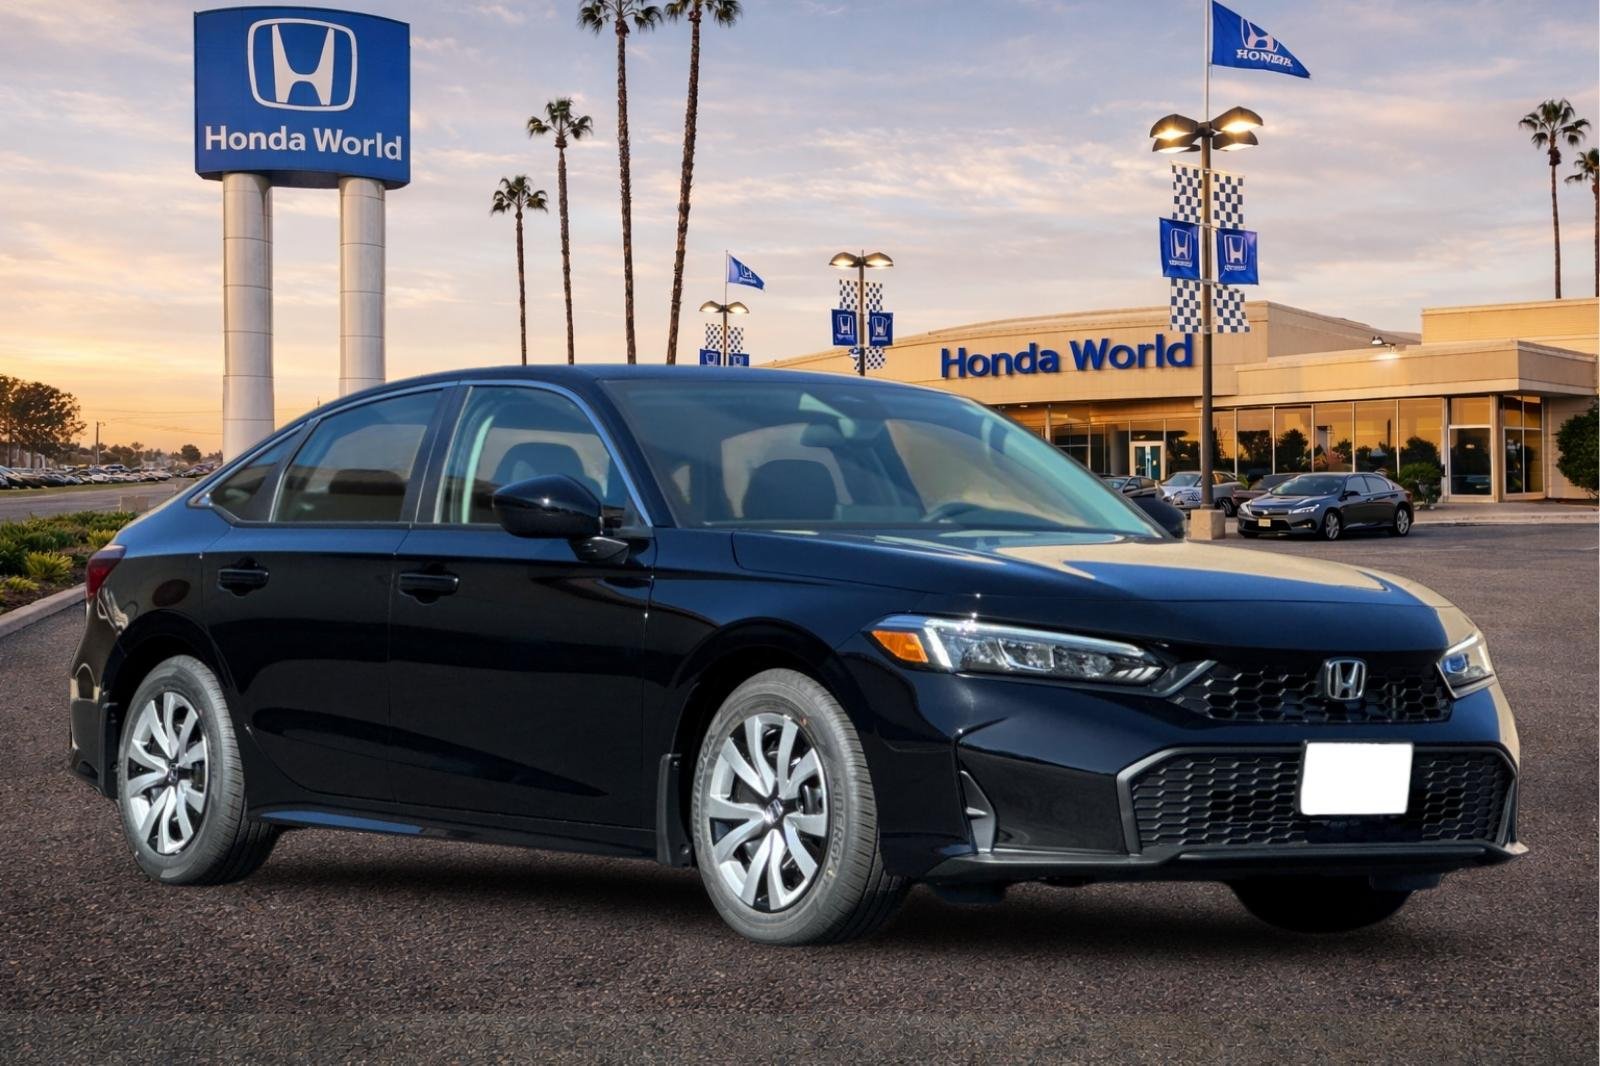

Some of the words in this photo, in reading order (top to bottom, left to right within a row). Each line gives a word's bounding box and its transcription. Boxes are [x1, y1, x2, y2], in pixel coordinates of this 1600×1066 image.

[205, 125, 306, 151] Honda
[312, 127, 402, 161] World
[941, 342, 1060, 378] Honda
[1069, 333, 1194, 371] World
[830, 777, 845, 867] KINERGY
